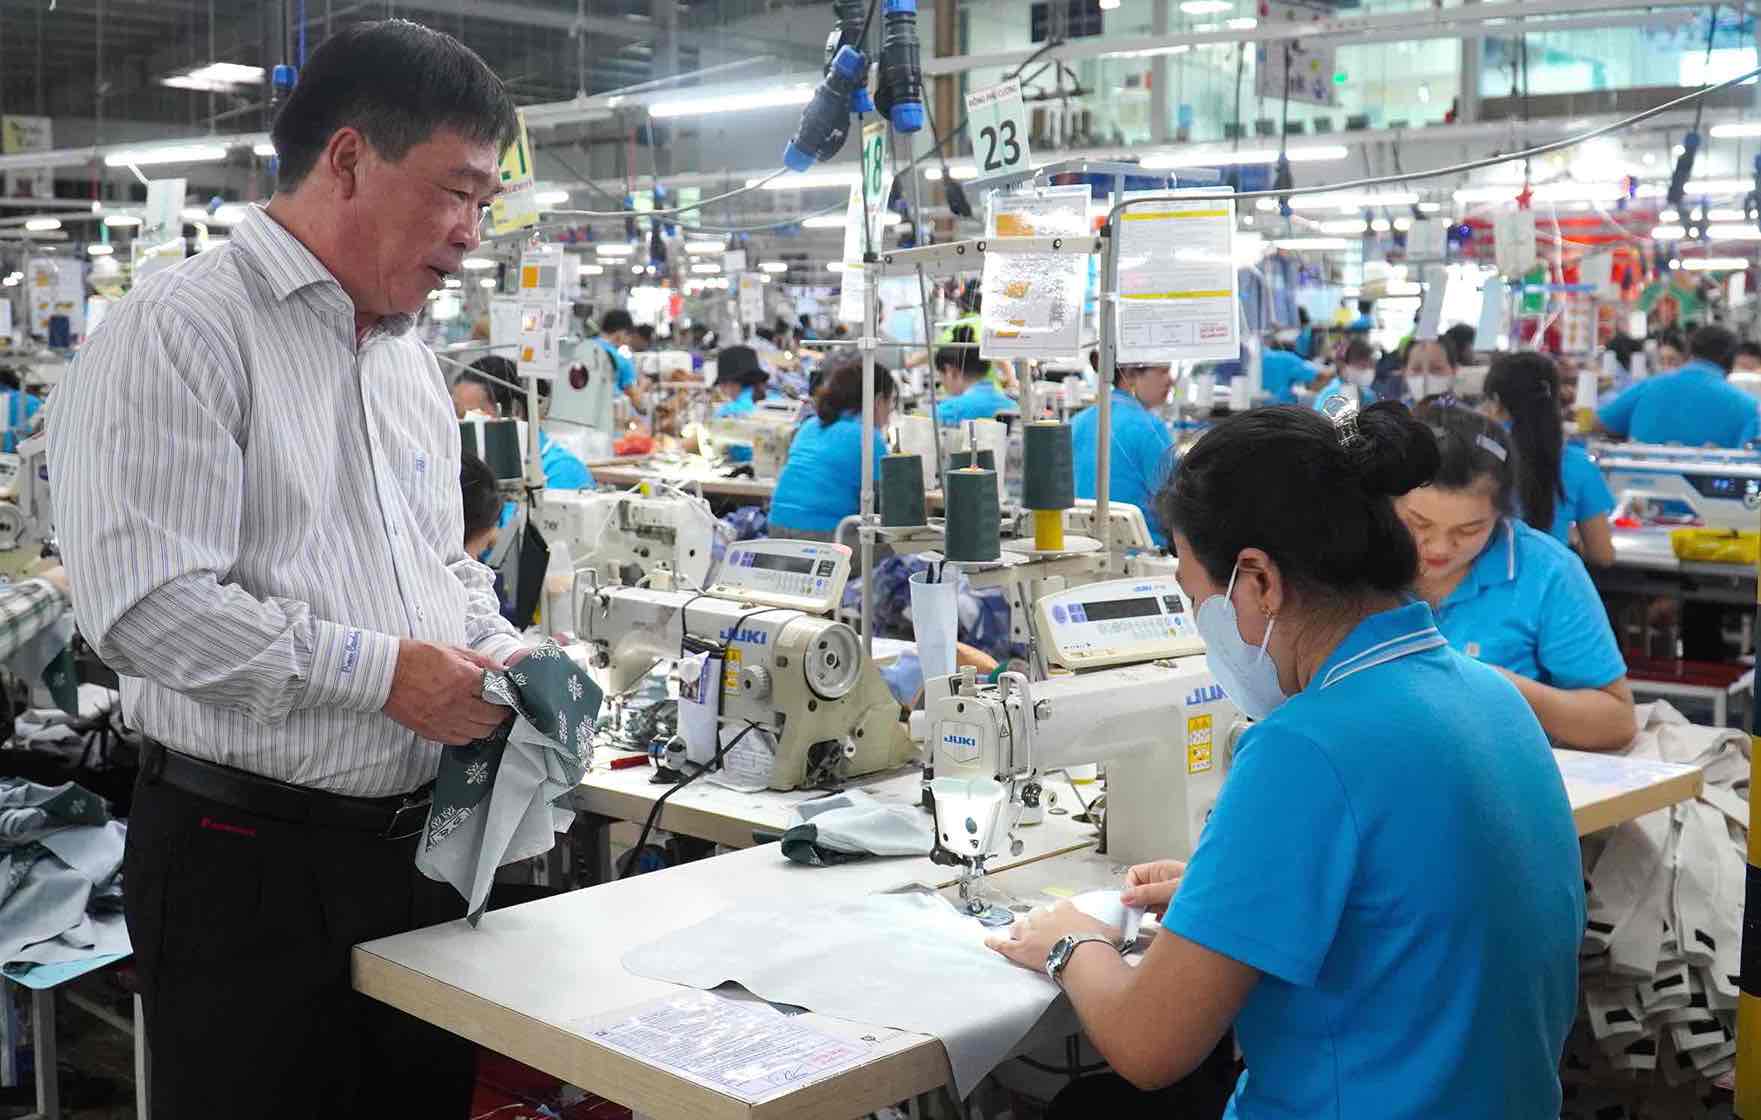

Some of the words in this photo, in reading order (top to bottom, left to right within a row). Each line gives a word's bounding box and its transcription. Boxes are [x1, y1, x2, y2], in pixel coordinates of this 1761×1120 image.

[980, 120, 1020, 171] 23
[863, 136, 882, 195] 18
[720, 628, 768, 644] JUKI
[1185, 683, 1228, 705] JUK
[944, 735, 976, 746] JUKI
